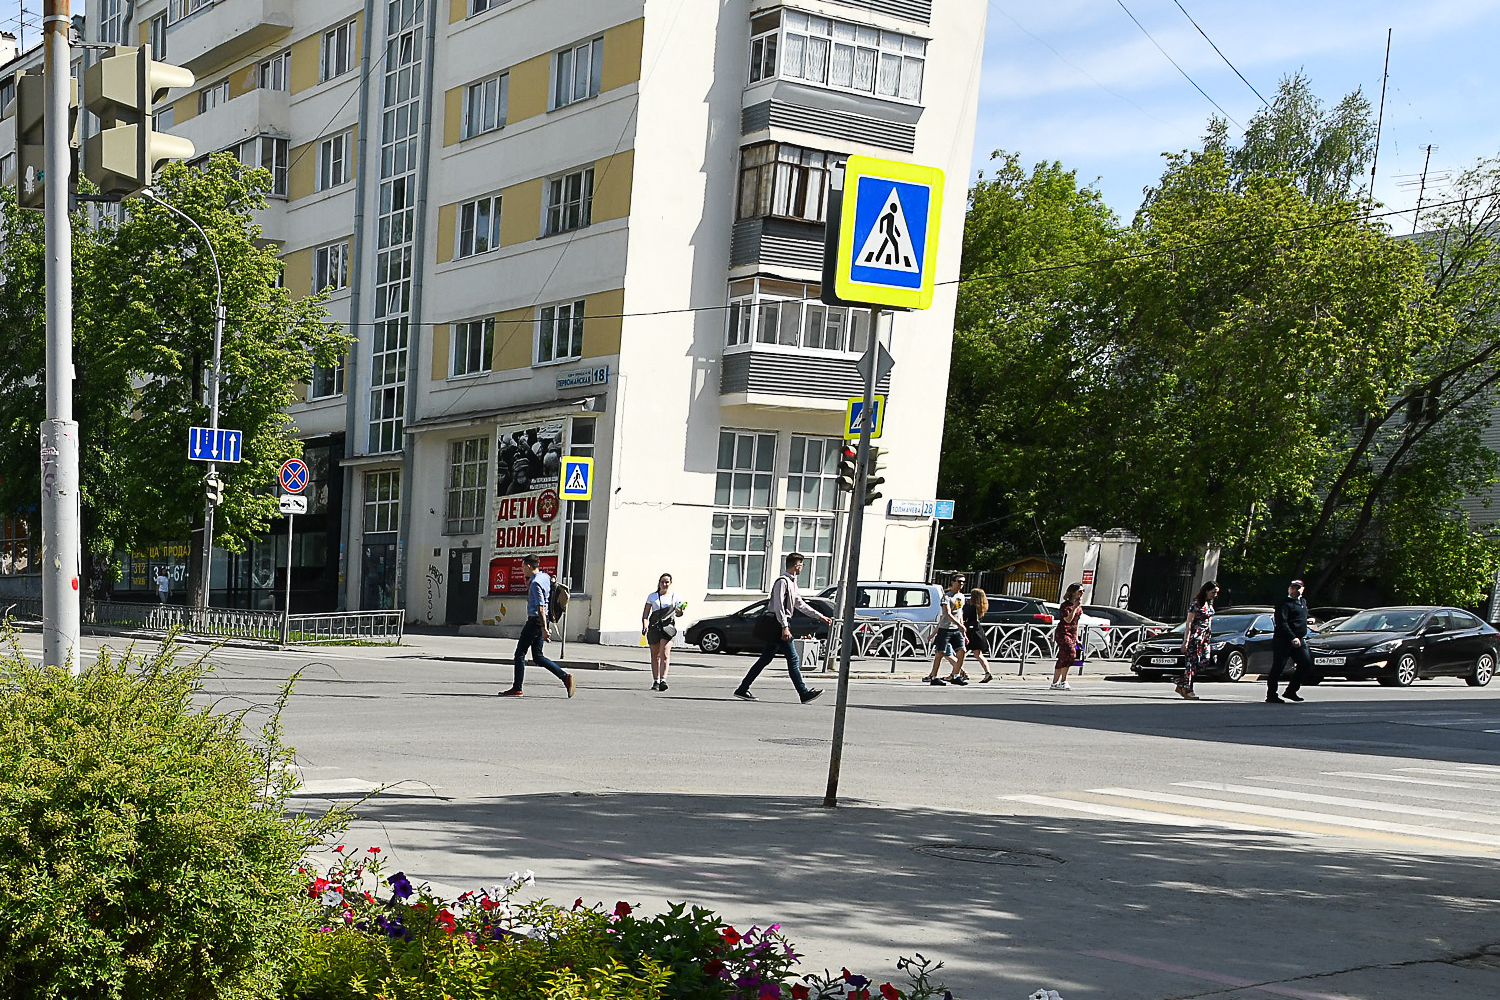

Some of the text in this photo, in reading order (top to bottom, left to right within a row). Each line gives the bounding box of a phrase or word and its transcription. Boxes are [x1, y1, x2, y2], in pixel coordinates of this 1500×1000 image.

[594, 369, 604, 382] 18
[497, 496, 537, 522] ДЕТИ
[924, 503, 933, 514] 28
[496, 521, 552, 549] ВОЙНЫ
[134, 563, 146, 574] 312
